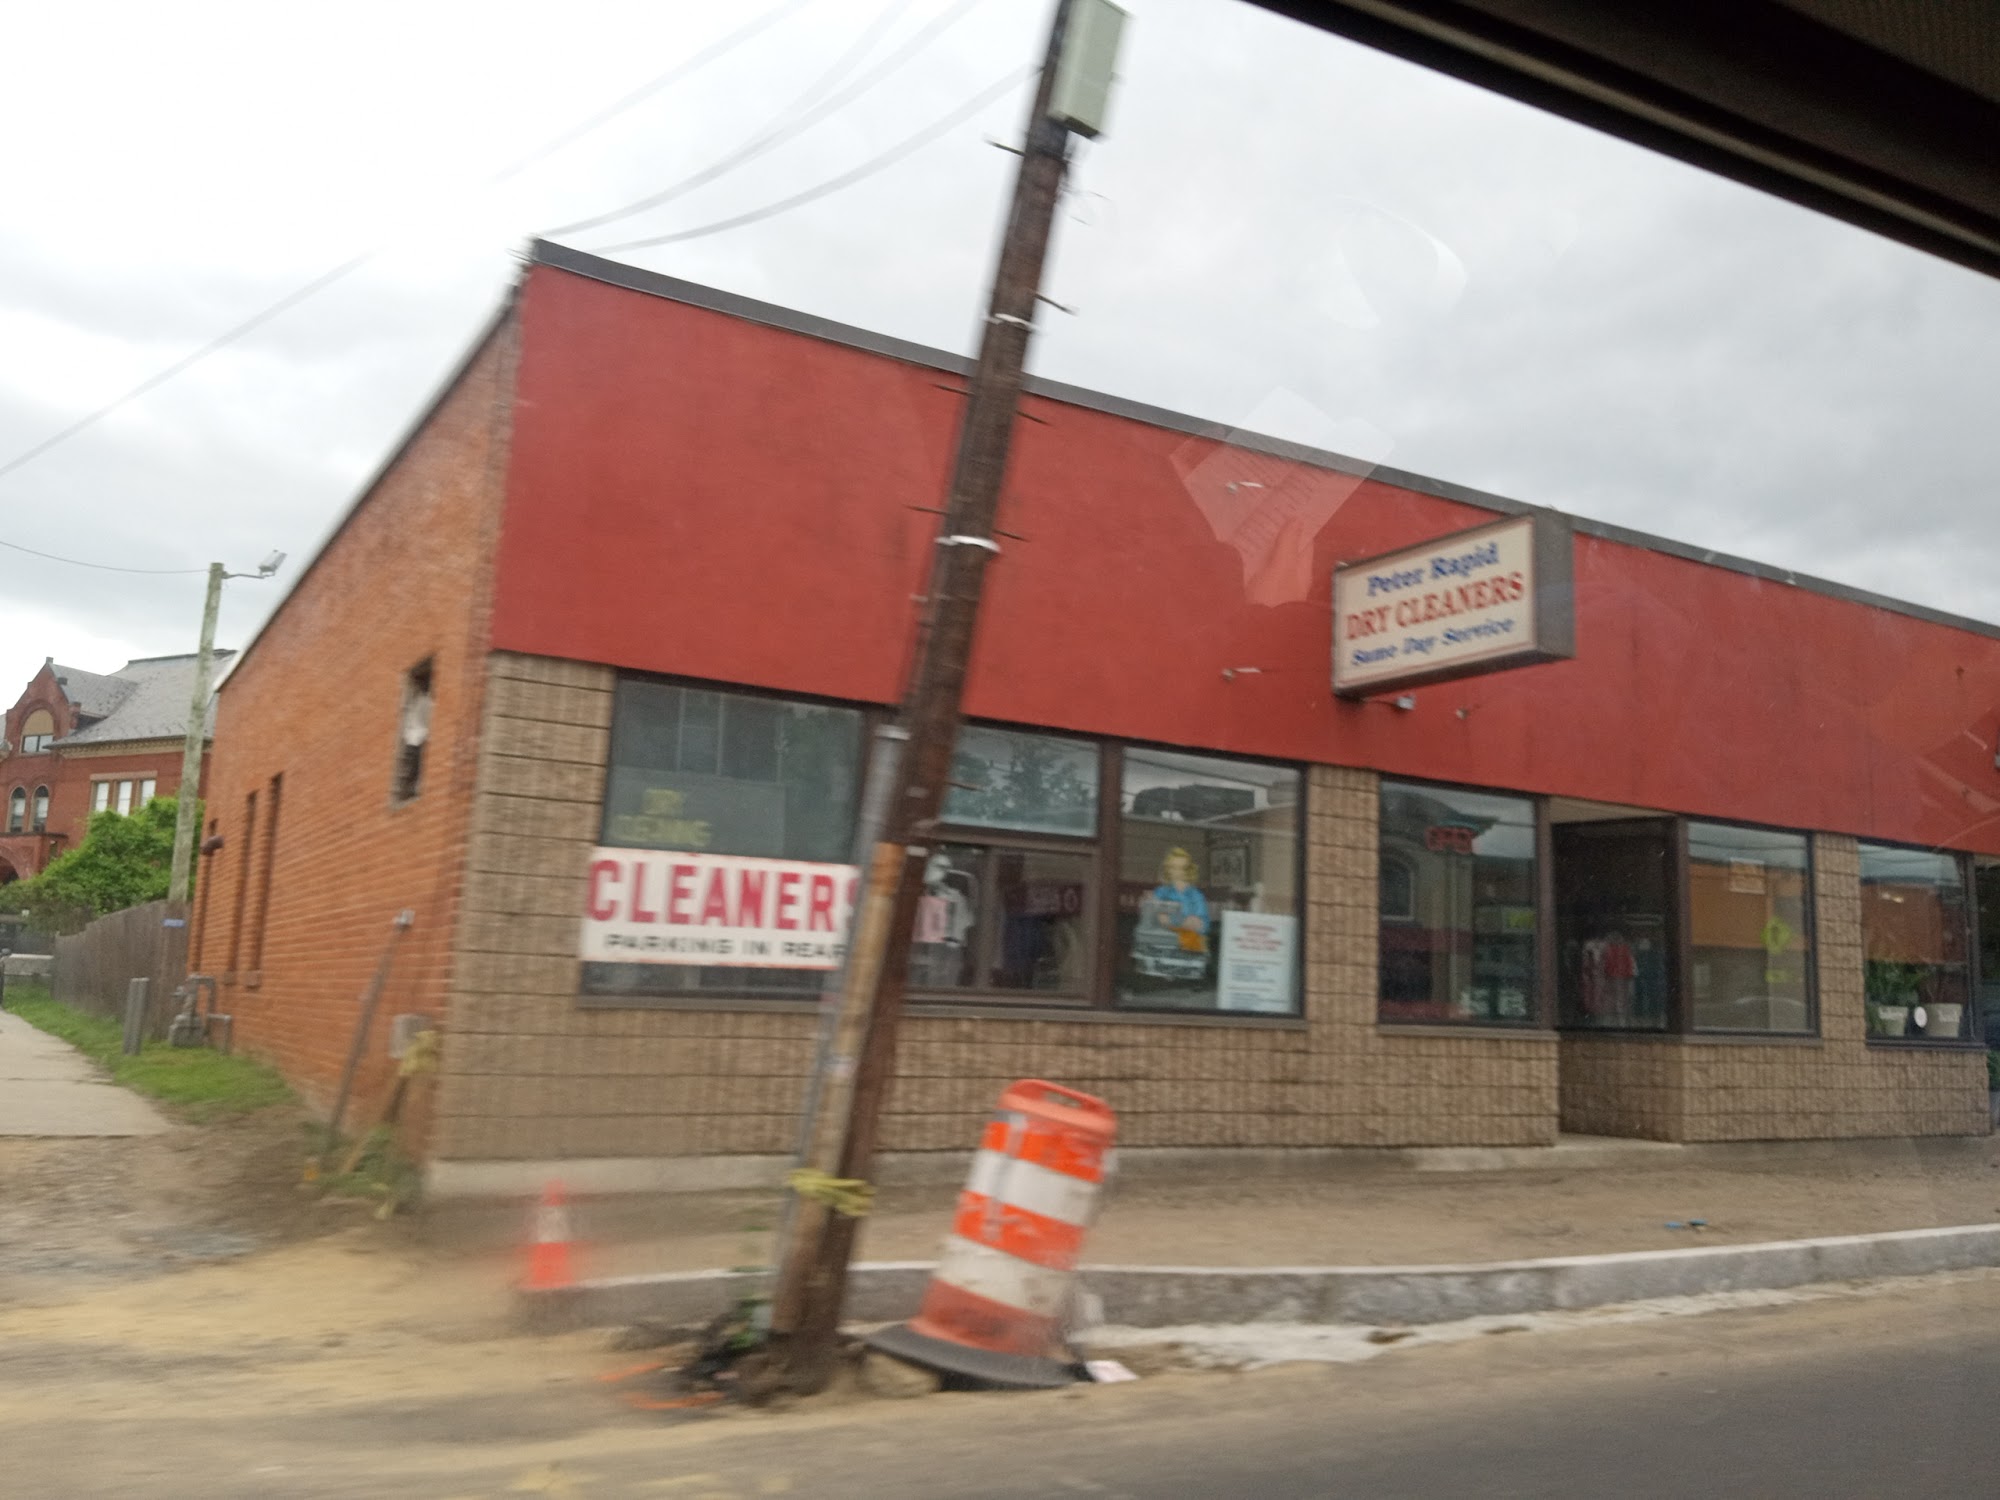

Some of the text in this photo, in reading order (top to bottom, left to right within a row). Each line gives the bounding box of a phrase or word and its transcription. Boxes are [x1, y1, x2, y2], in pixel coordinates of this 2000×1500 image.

[1345, 571, 1524, 641] DRY CLEANERS
[606, 933, 734, 956] PARKING
[742, 940, 773, 955] IN
